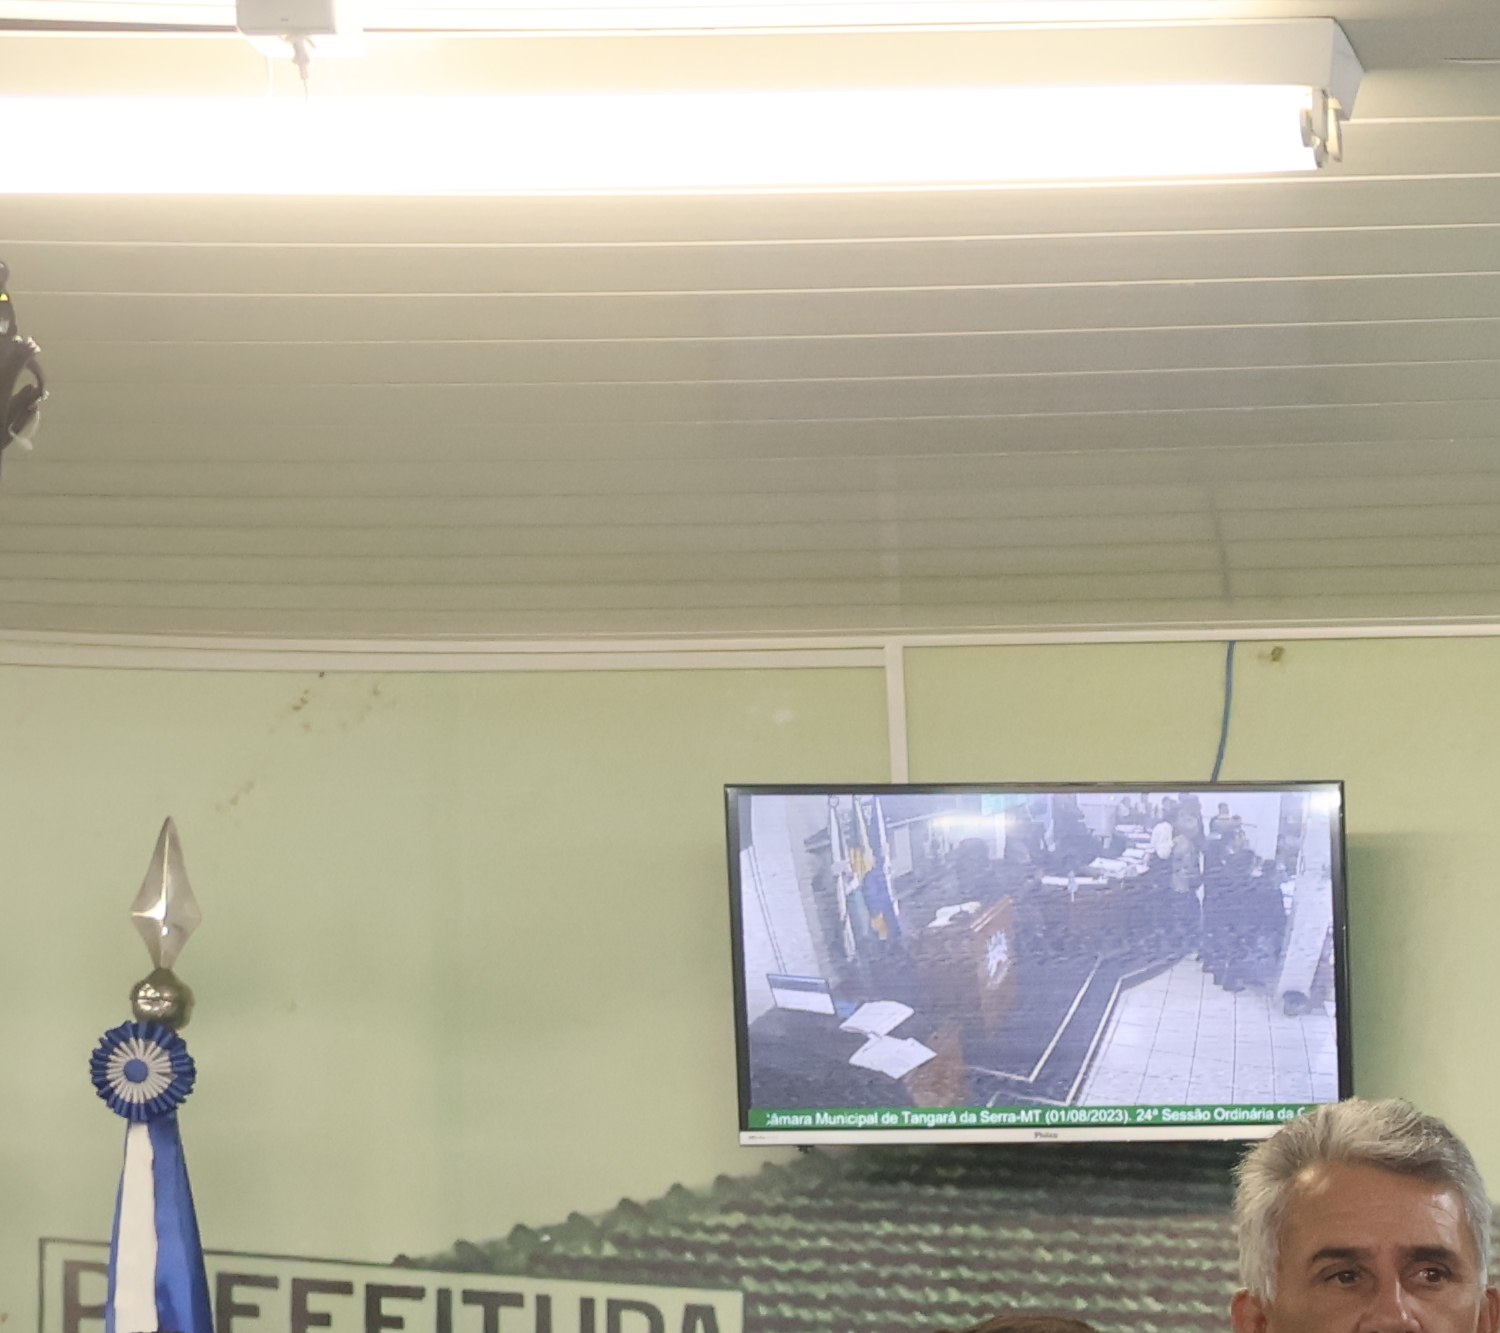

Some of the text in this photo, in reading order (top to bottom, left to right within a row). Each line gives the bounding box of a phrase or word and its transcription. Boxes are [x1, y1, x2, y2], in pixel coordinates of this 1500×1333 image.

[815, 1110, 878, 1127] Municipal
[882, 1110, 898, 1124] de
[903, 1110, 956, 1128] Tangará
[960, 1110, 976, 1124] da
[980, 1110, 1041, 1125] Serra-MT
[1162, 1108, 1211, 1121] Sessão
[1214, 1106, 1273, 1120] Ordinária
[1277, 1107, 1294, 1120] da
